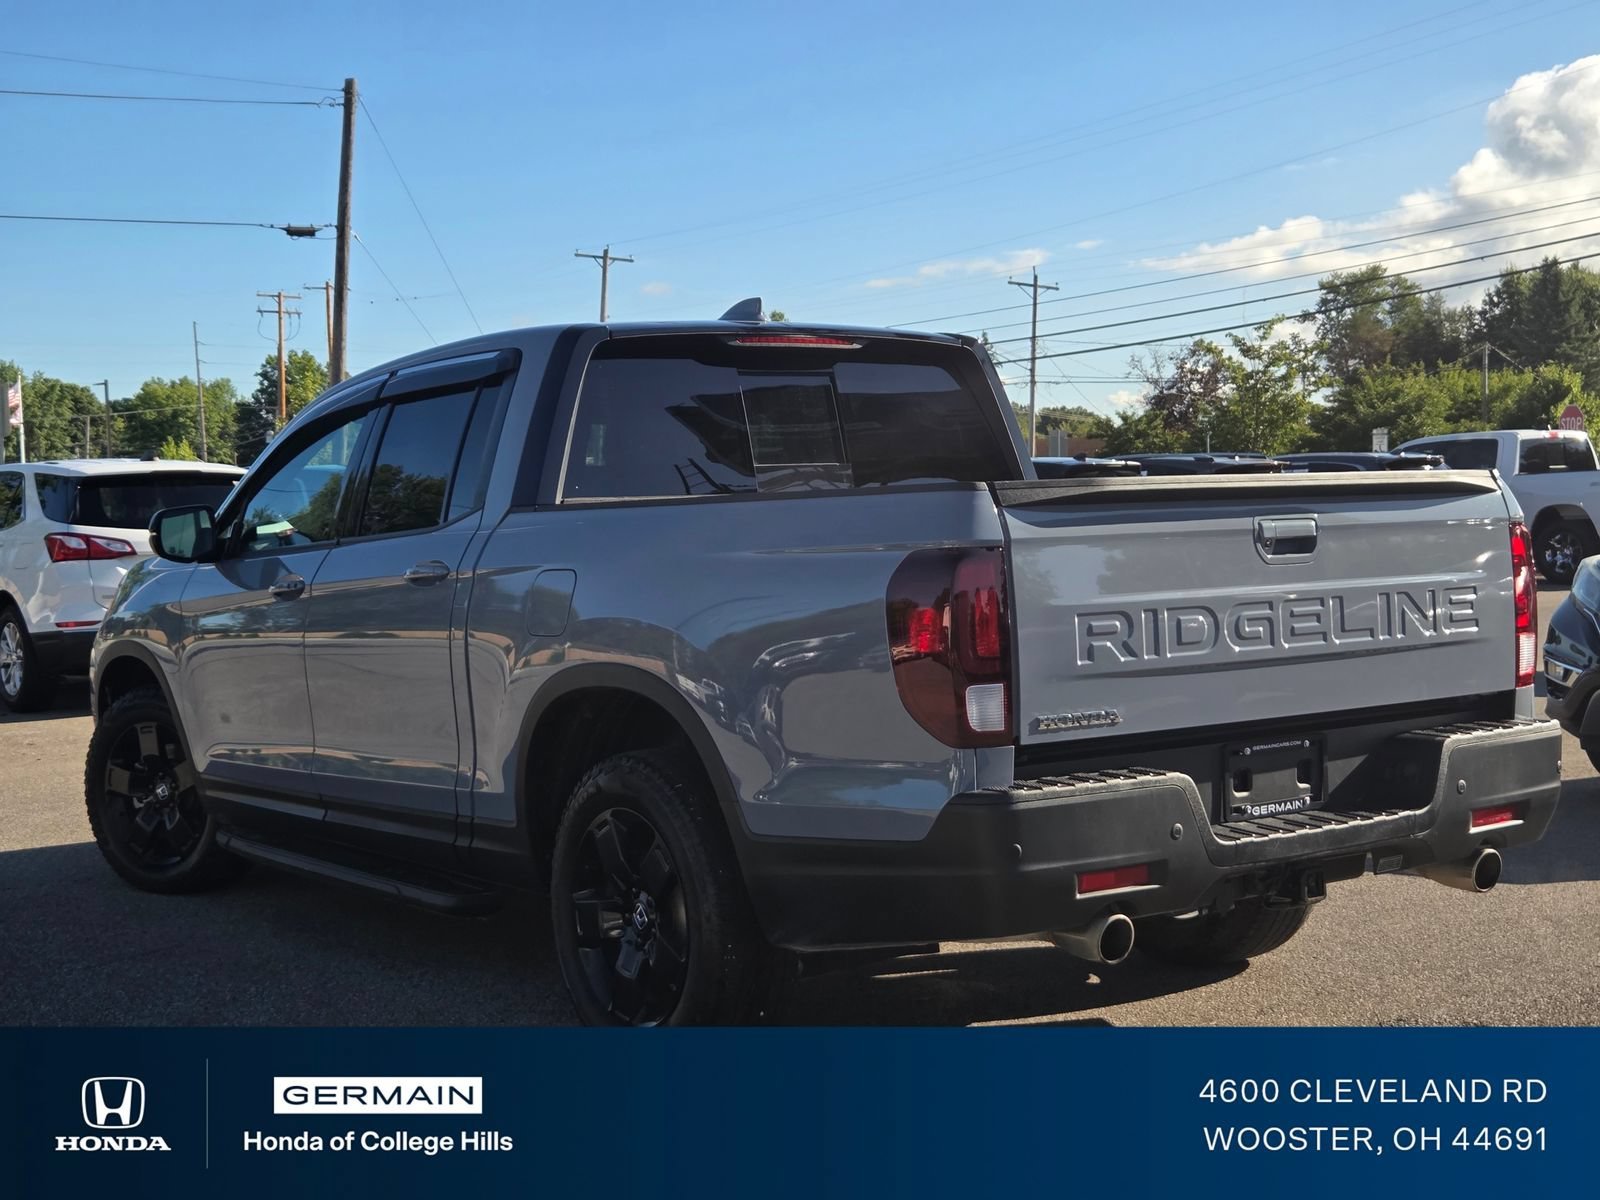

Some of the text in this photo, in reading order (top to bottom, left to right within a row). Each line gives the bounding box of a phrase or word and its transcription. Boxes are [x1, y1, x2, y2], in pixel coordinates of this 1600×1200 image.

[1561, 417, 1582, 430] STOP
[1075, 586, 1478, 665] RIDGELINE
[1037, 709, 1121, 729] HONDA
[1252, 800, 1303, 815] GERMAIN
